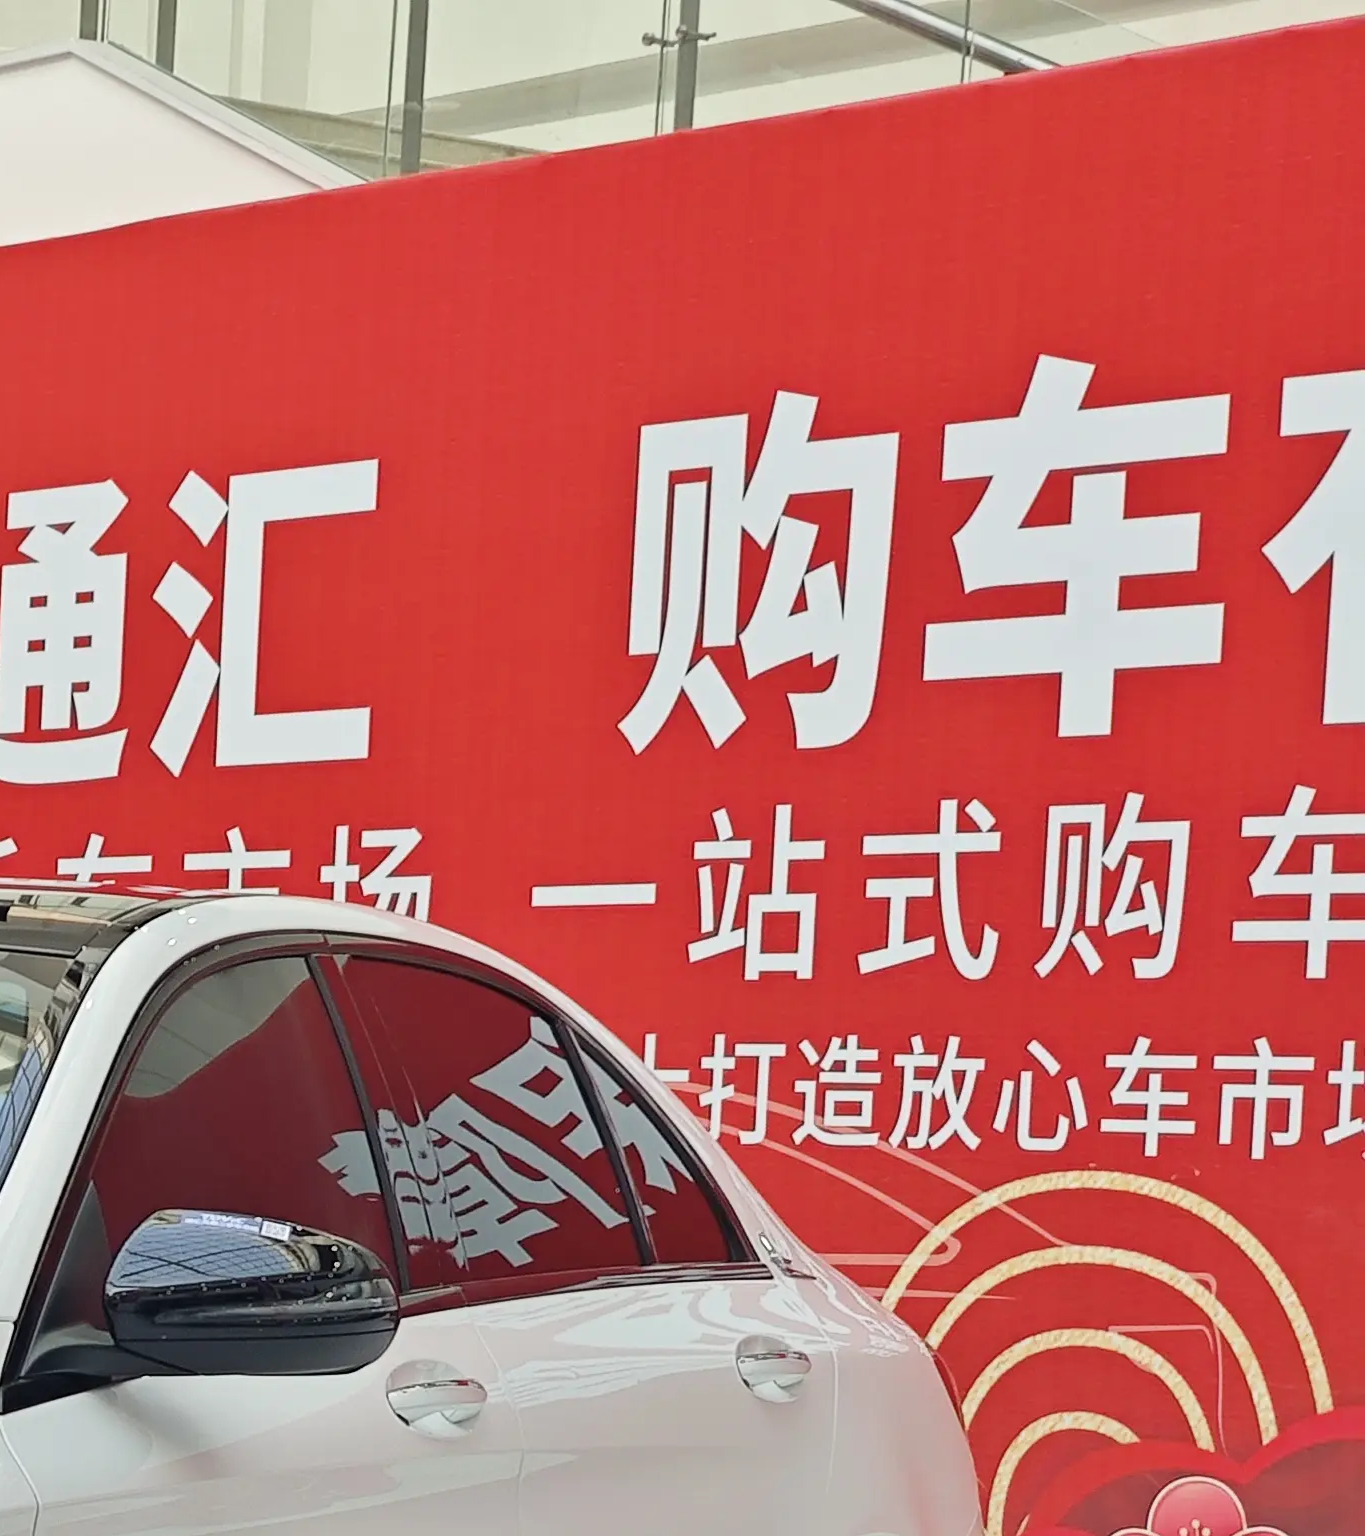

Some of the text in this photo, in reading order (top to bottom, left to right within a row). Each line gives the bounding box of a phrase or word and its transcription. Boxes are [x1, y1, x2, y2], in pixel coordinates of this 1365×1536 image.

[530, 785, 1365, 982] 一站式购车
